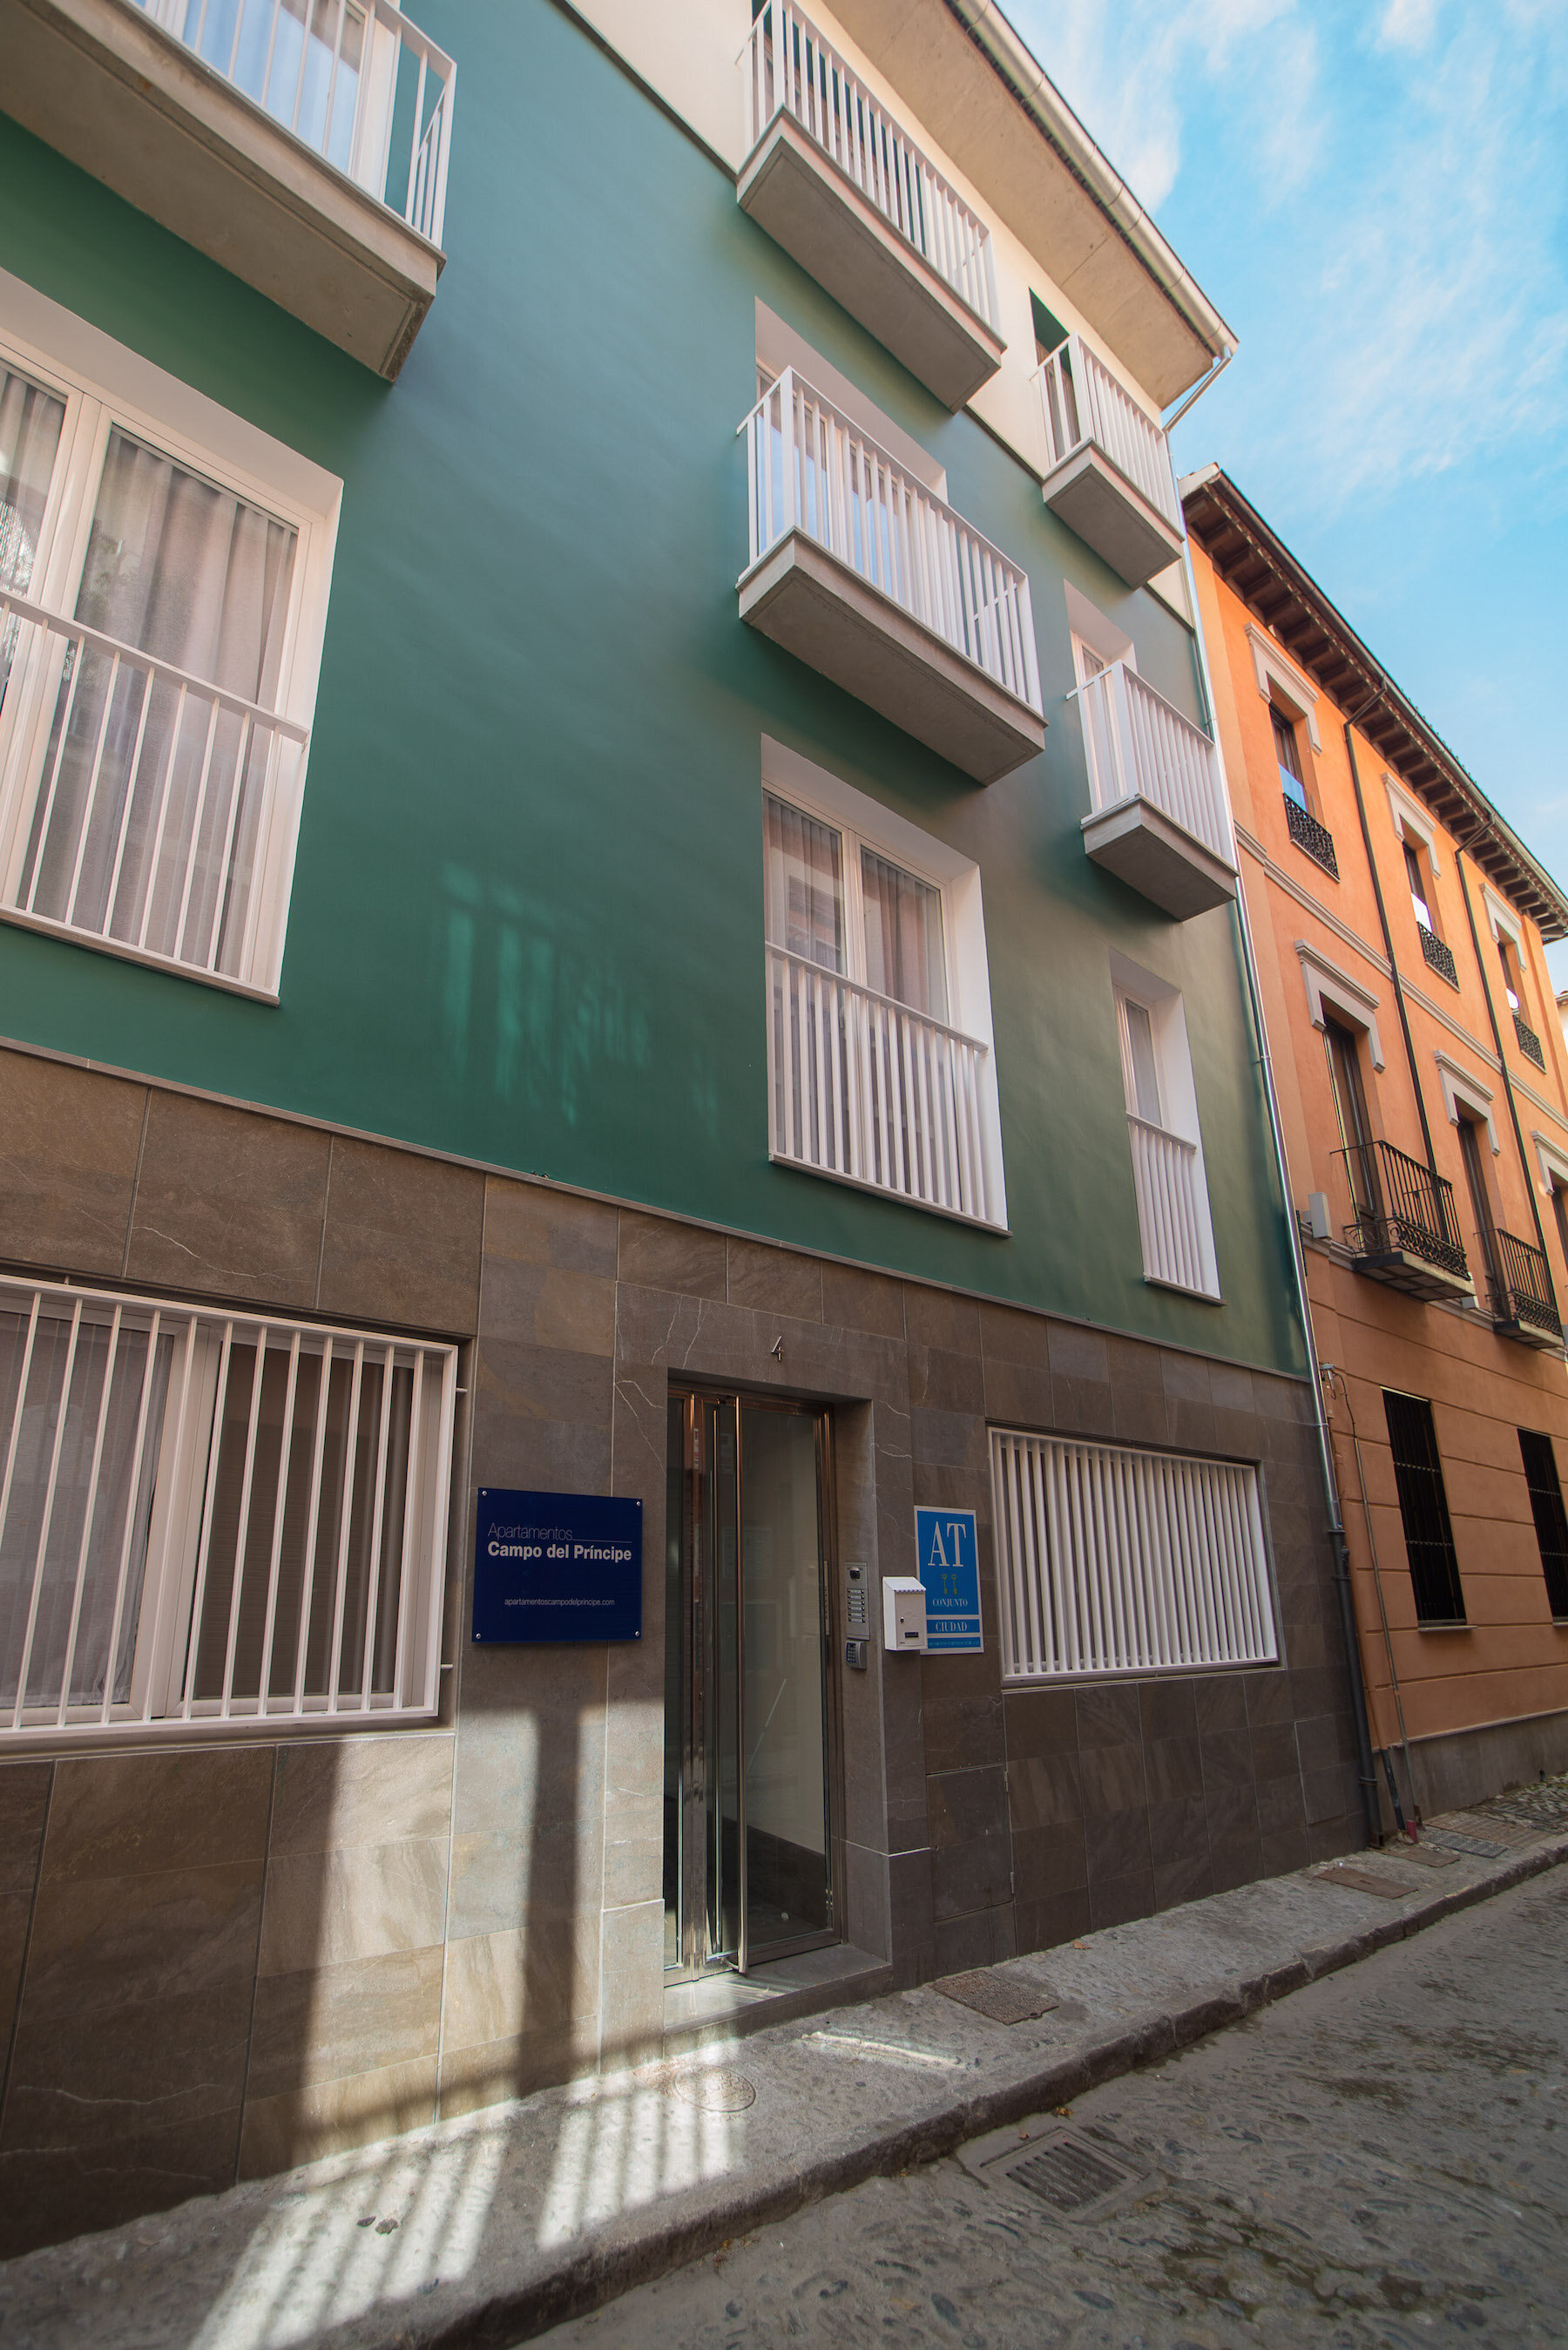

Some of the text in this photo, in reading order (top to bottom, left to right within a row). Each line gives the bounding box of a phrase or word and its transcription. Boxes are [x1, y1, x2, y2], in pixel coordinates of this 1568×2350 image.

[771, 1336, 784, 1361] 4
[487, 1522, 573, 1541] Apartamentos
[487, 1541, 632, 1563] Campo del Príncipe
[927, 1520, 967, 1568] AT
[932, 1597, 969, 1608] CONJUNTO
[935, 1622, 968, 1632] CIUDAD
